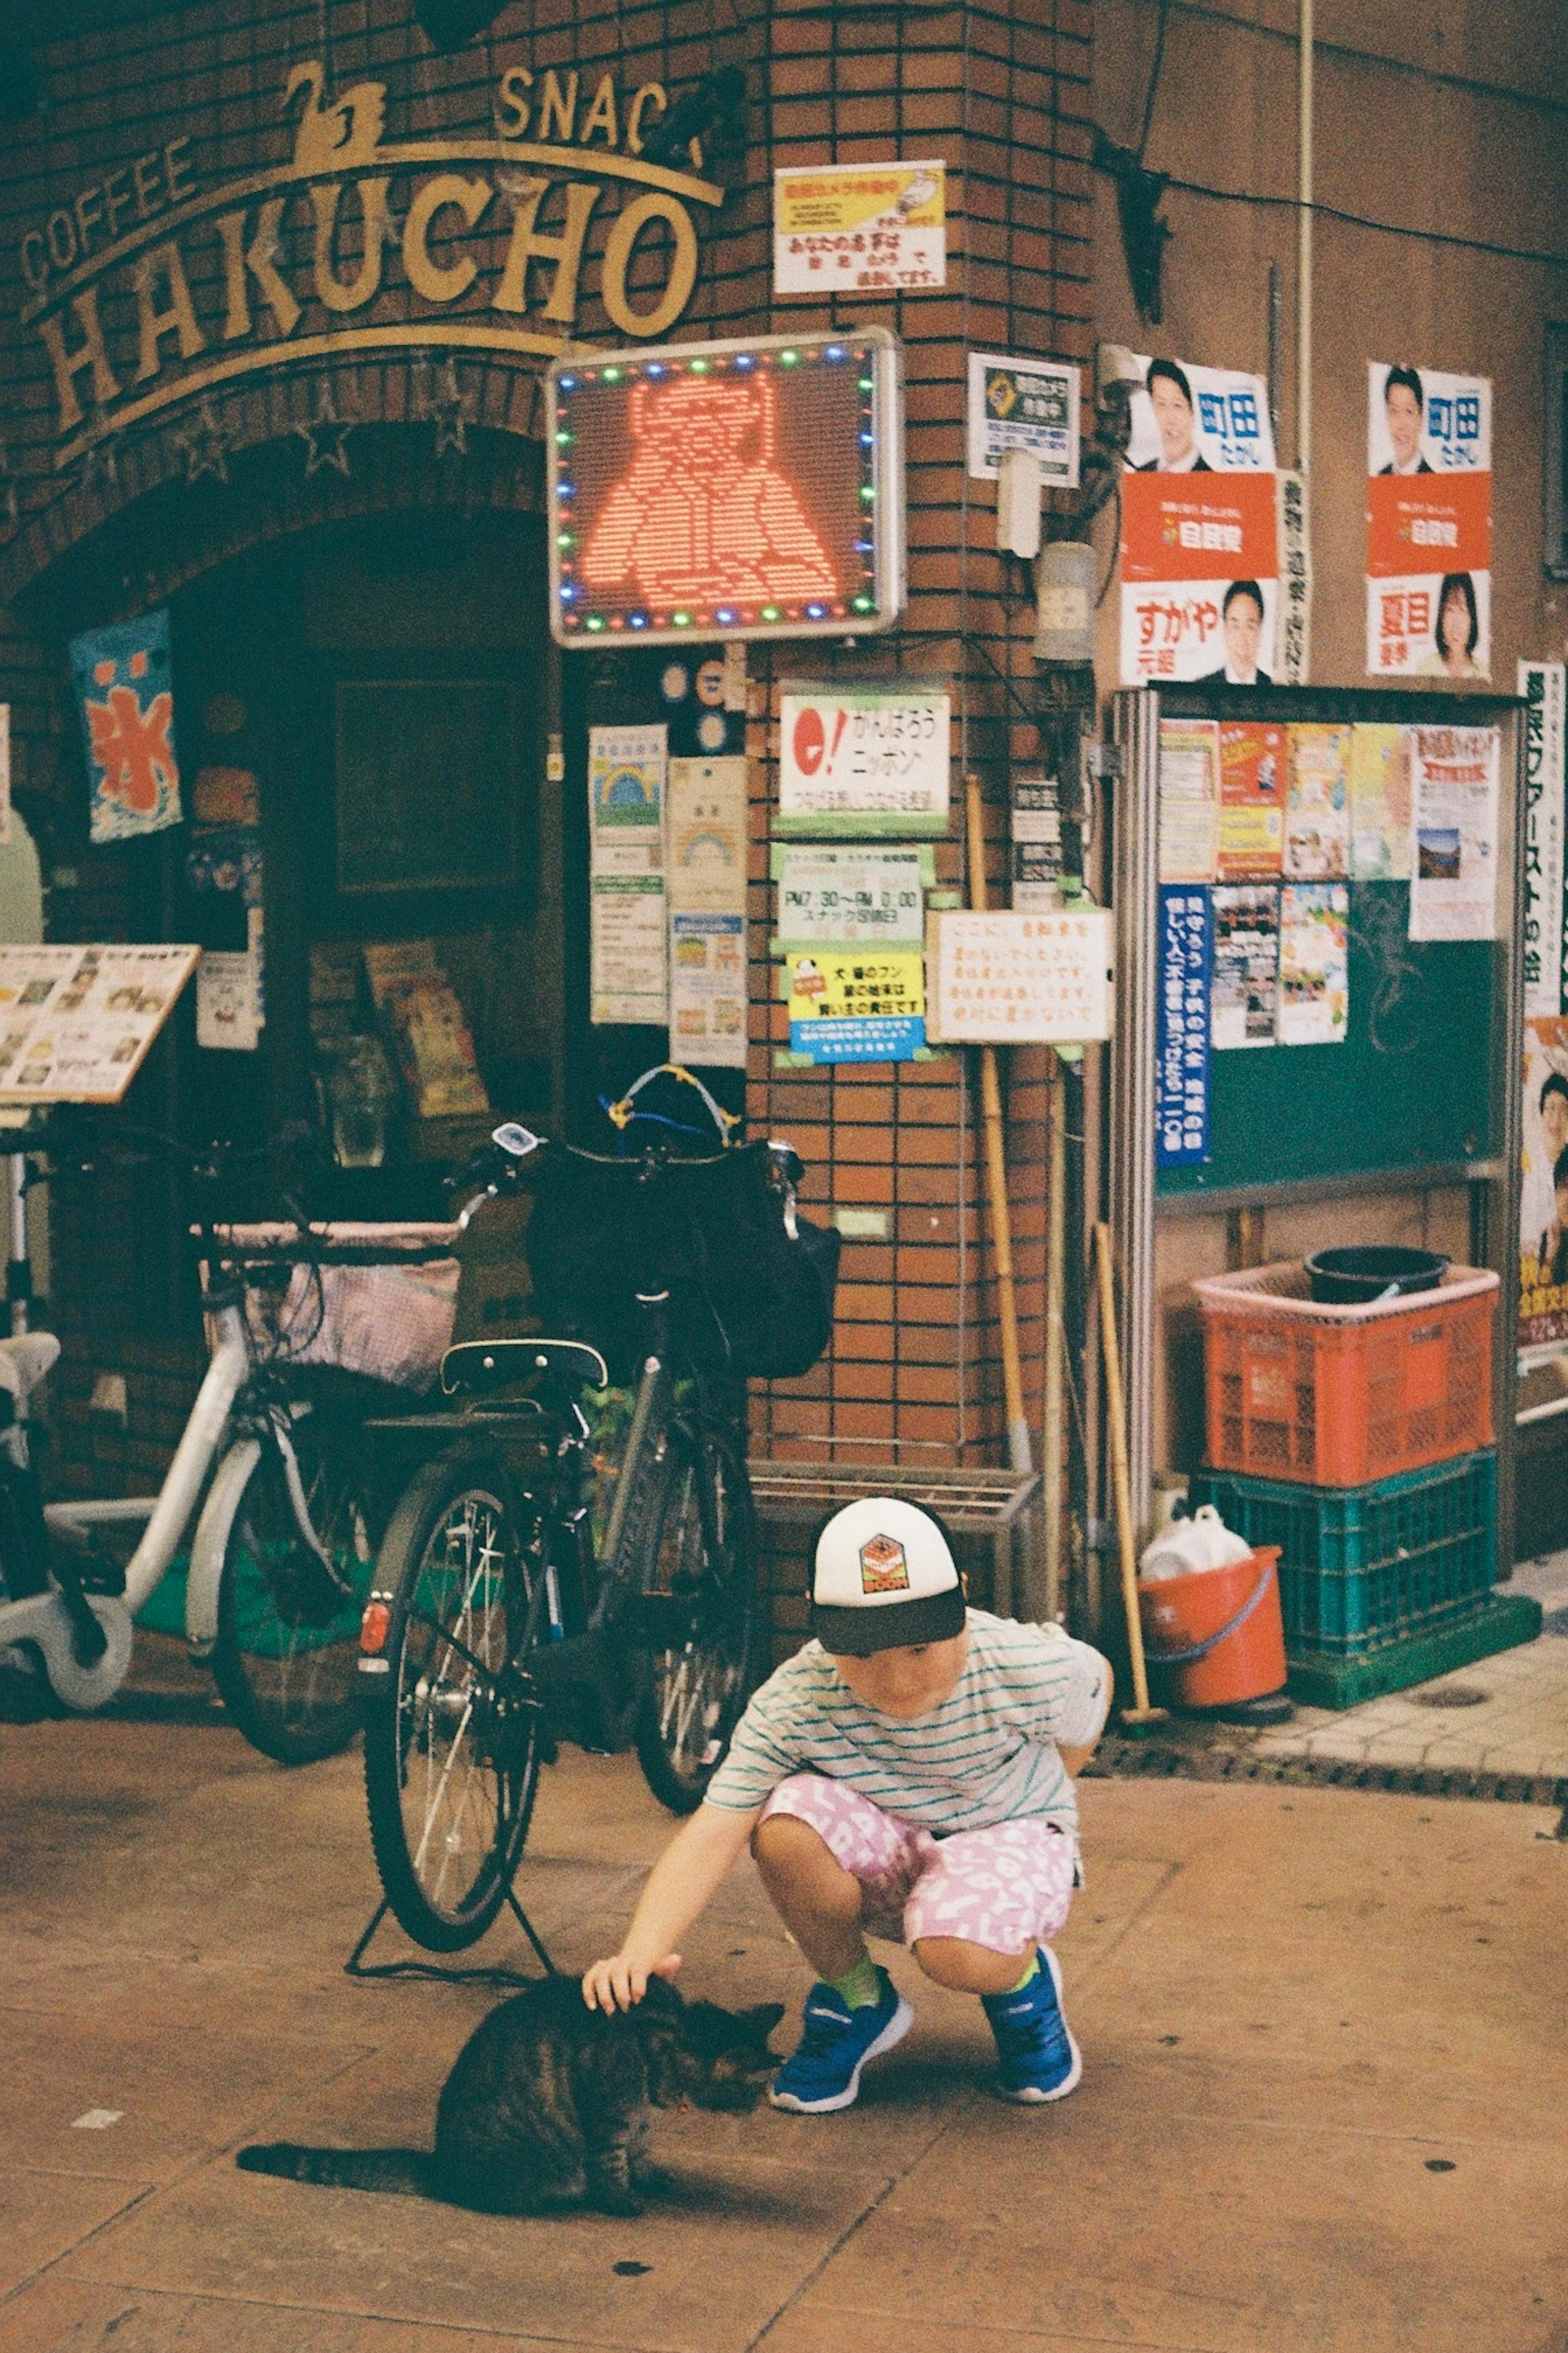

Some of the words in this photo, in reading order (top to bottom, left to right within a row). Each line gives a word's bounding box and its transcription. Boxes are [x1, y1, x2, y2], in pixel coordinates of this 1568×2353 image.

[498, 66, 704, 169] SNAC
[20, 134, 199, 288] COFFEE
[38, 175, 698, 434] HAKUCHO
[1198, 393, 1260, 439] 町田
[1428, 397, 1479, 441] 町田
[1179, 519, 1243, 554] 自民党
[1136, 601, 1221, 645] すがや
[853, 708, 936, 740] がんばろう
[852, 746, 922, 776] ニッポン
